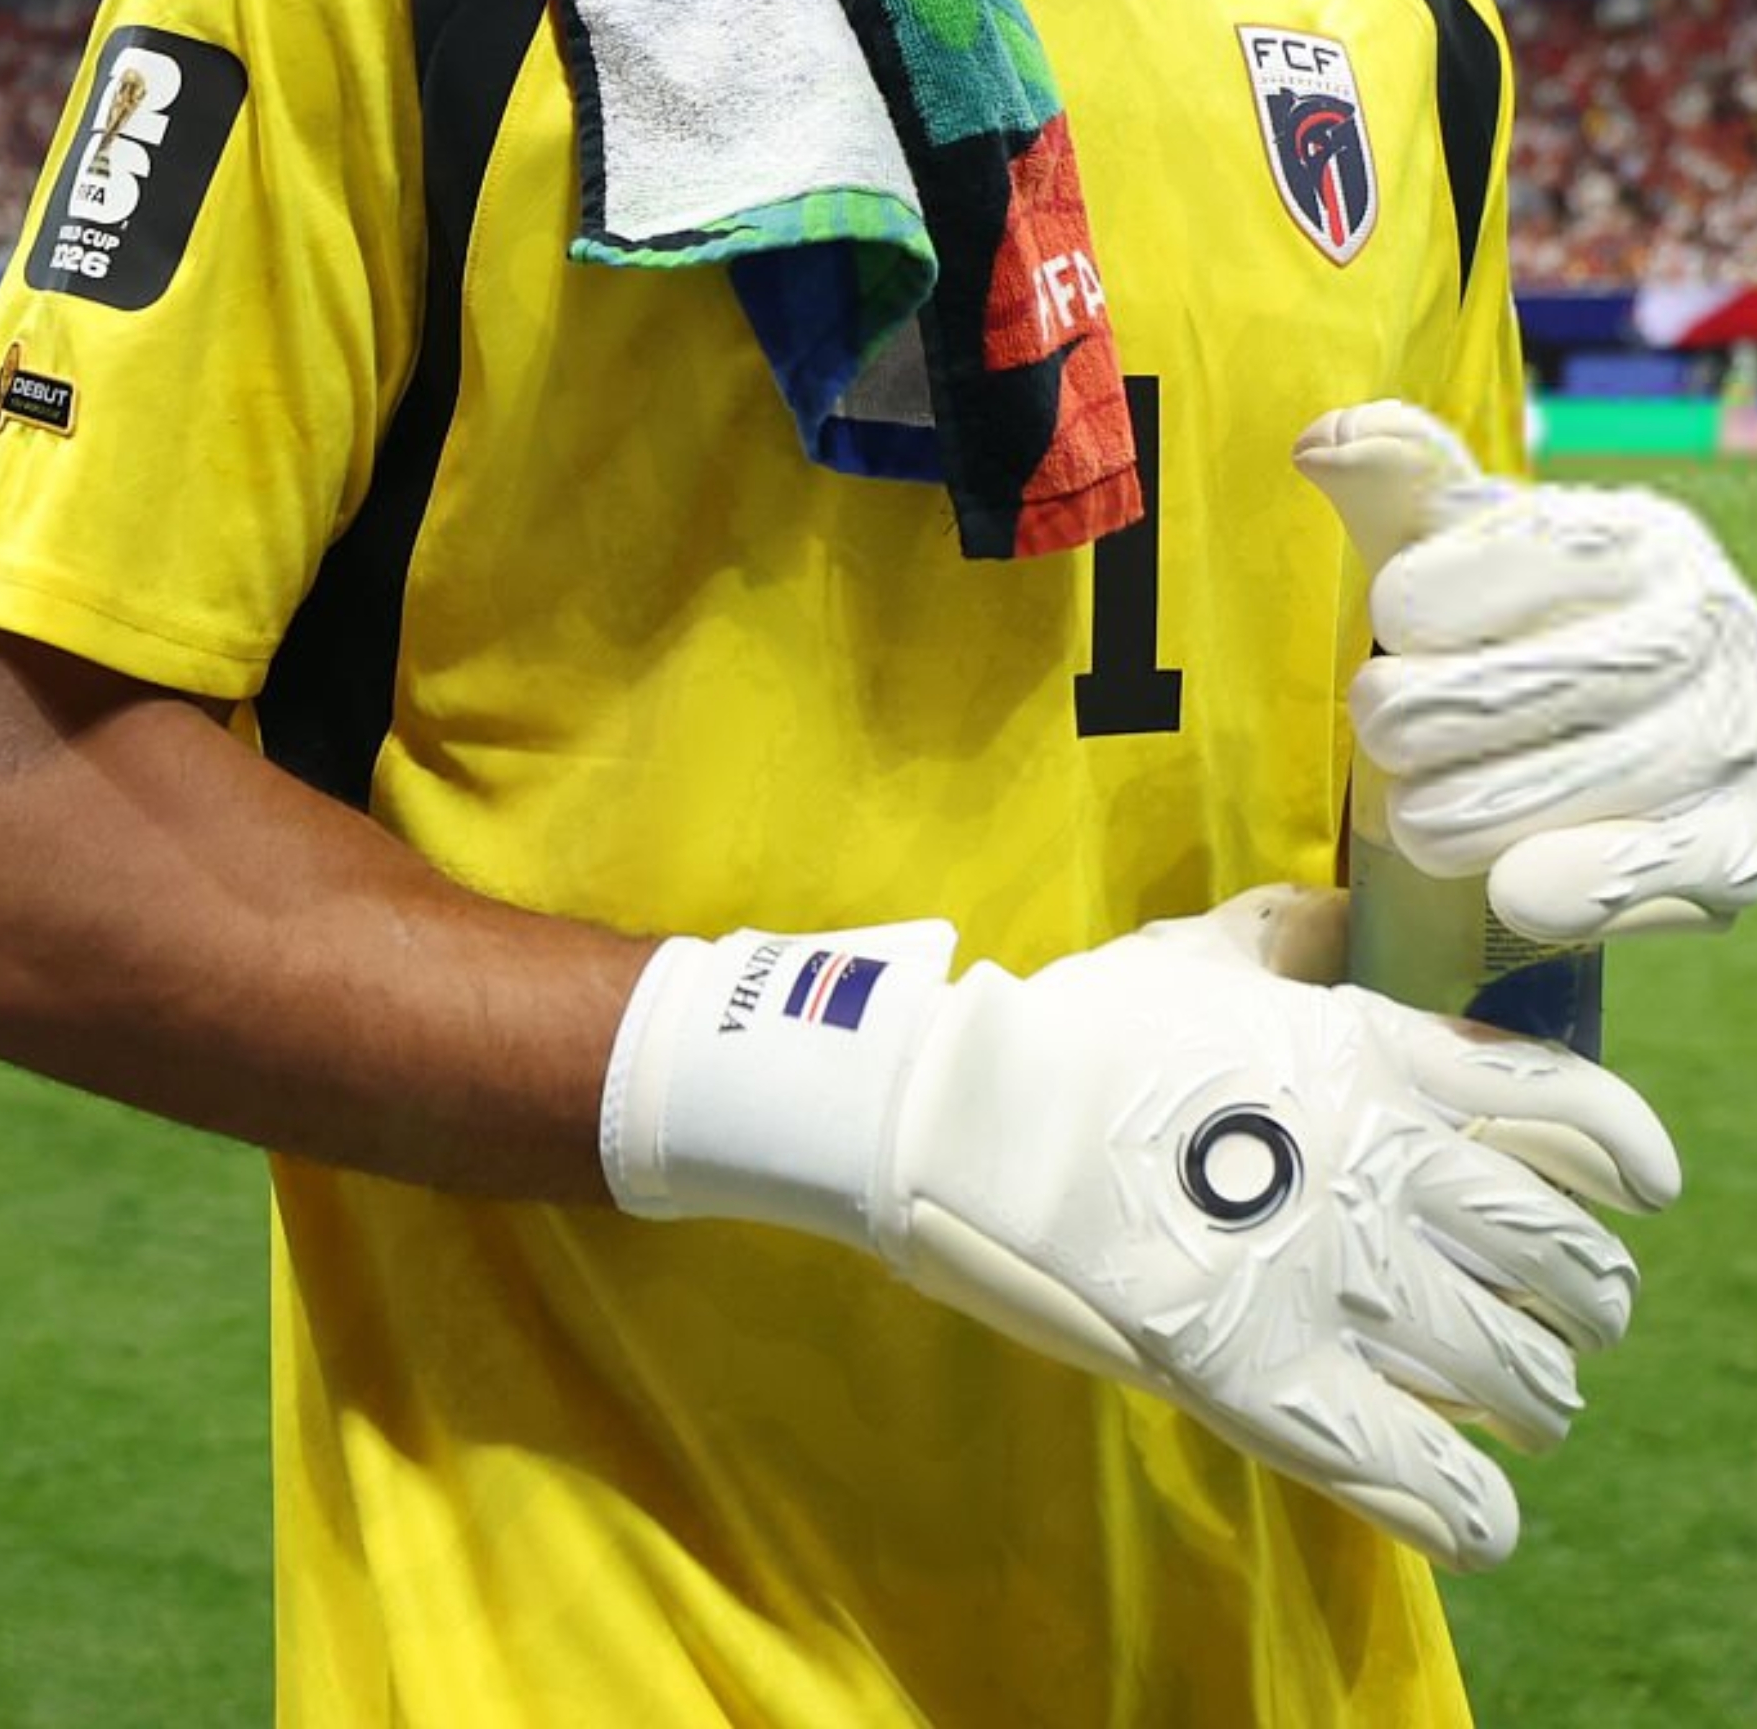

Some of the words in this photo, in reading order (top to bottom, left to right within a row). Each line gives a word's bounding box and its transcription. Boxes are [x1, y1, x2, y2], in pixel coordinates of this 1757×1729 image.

[1252, 37, 1339, 74] FCF
[78, 184, 105, 206] FA
[82, 227, 120, 250] CUP
[12, 376, 69, 407] DEBUT
[1074, 374, 1183, 739] 1
